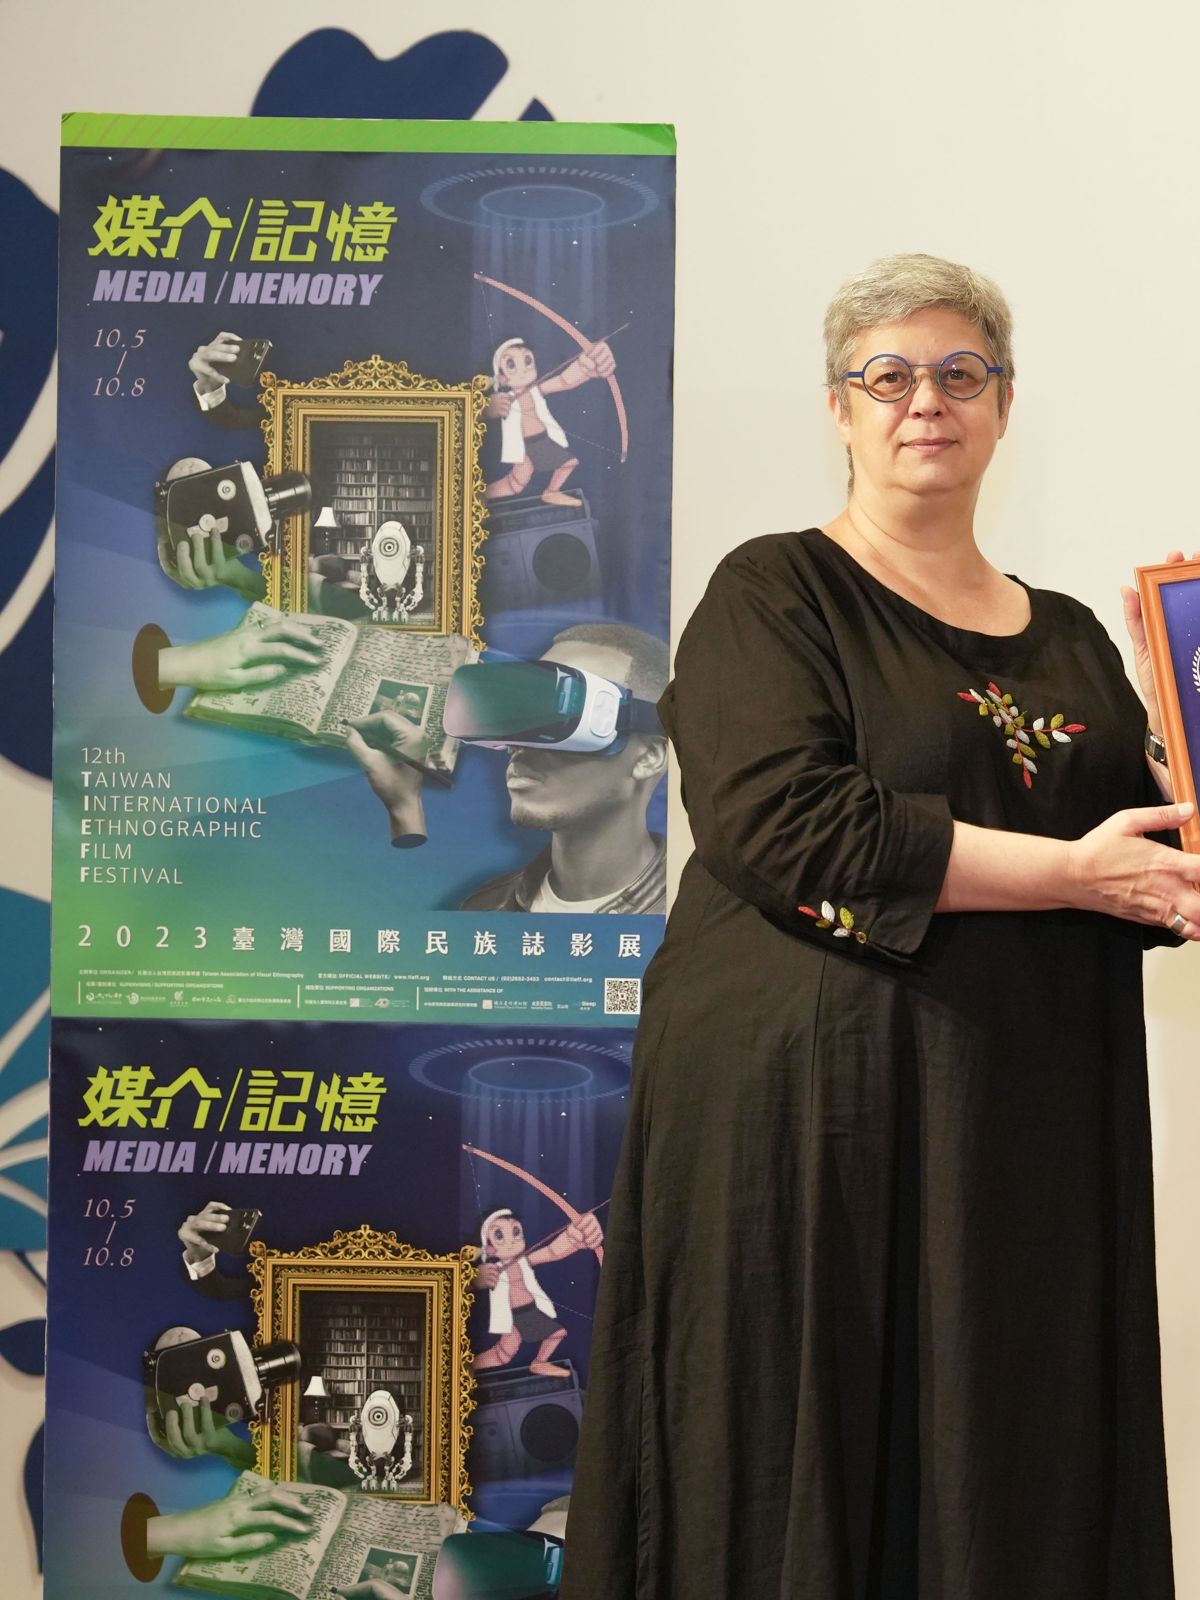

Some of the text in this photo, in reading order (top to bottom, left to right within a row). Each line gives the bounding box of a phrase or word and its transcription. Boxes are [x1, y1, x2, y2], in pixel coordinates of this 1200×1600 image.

[92, 270, 206, 304] MEDIA
[230, 272, 383, 306] MEMORY
[93, 328, 146, 348] 10.5
[93, 377, 145, 397] 10.8
[81, 747, 125, 764] 12th
[81, 771, 172, 789] TAIWAN
[84, 795, 267, 814] INTERNATIONAL
[81, 819, 262, 838] ETHNOGRAPHIC
[80, 843, 132, 860] FILM
[80, 867, 184, 885] FESTIVAL
[82, 1140, 197, 1173] MEDIA
[220, 1143, 373, 1176] MEMORY
[83, 1198, 136, 1218] 10.5
[83, 1246, 134, 1267] 10.8
